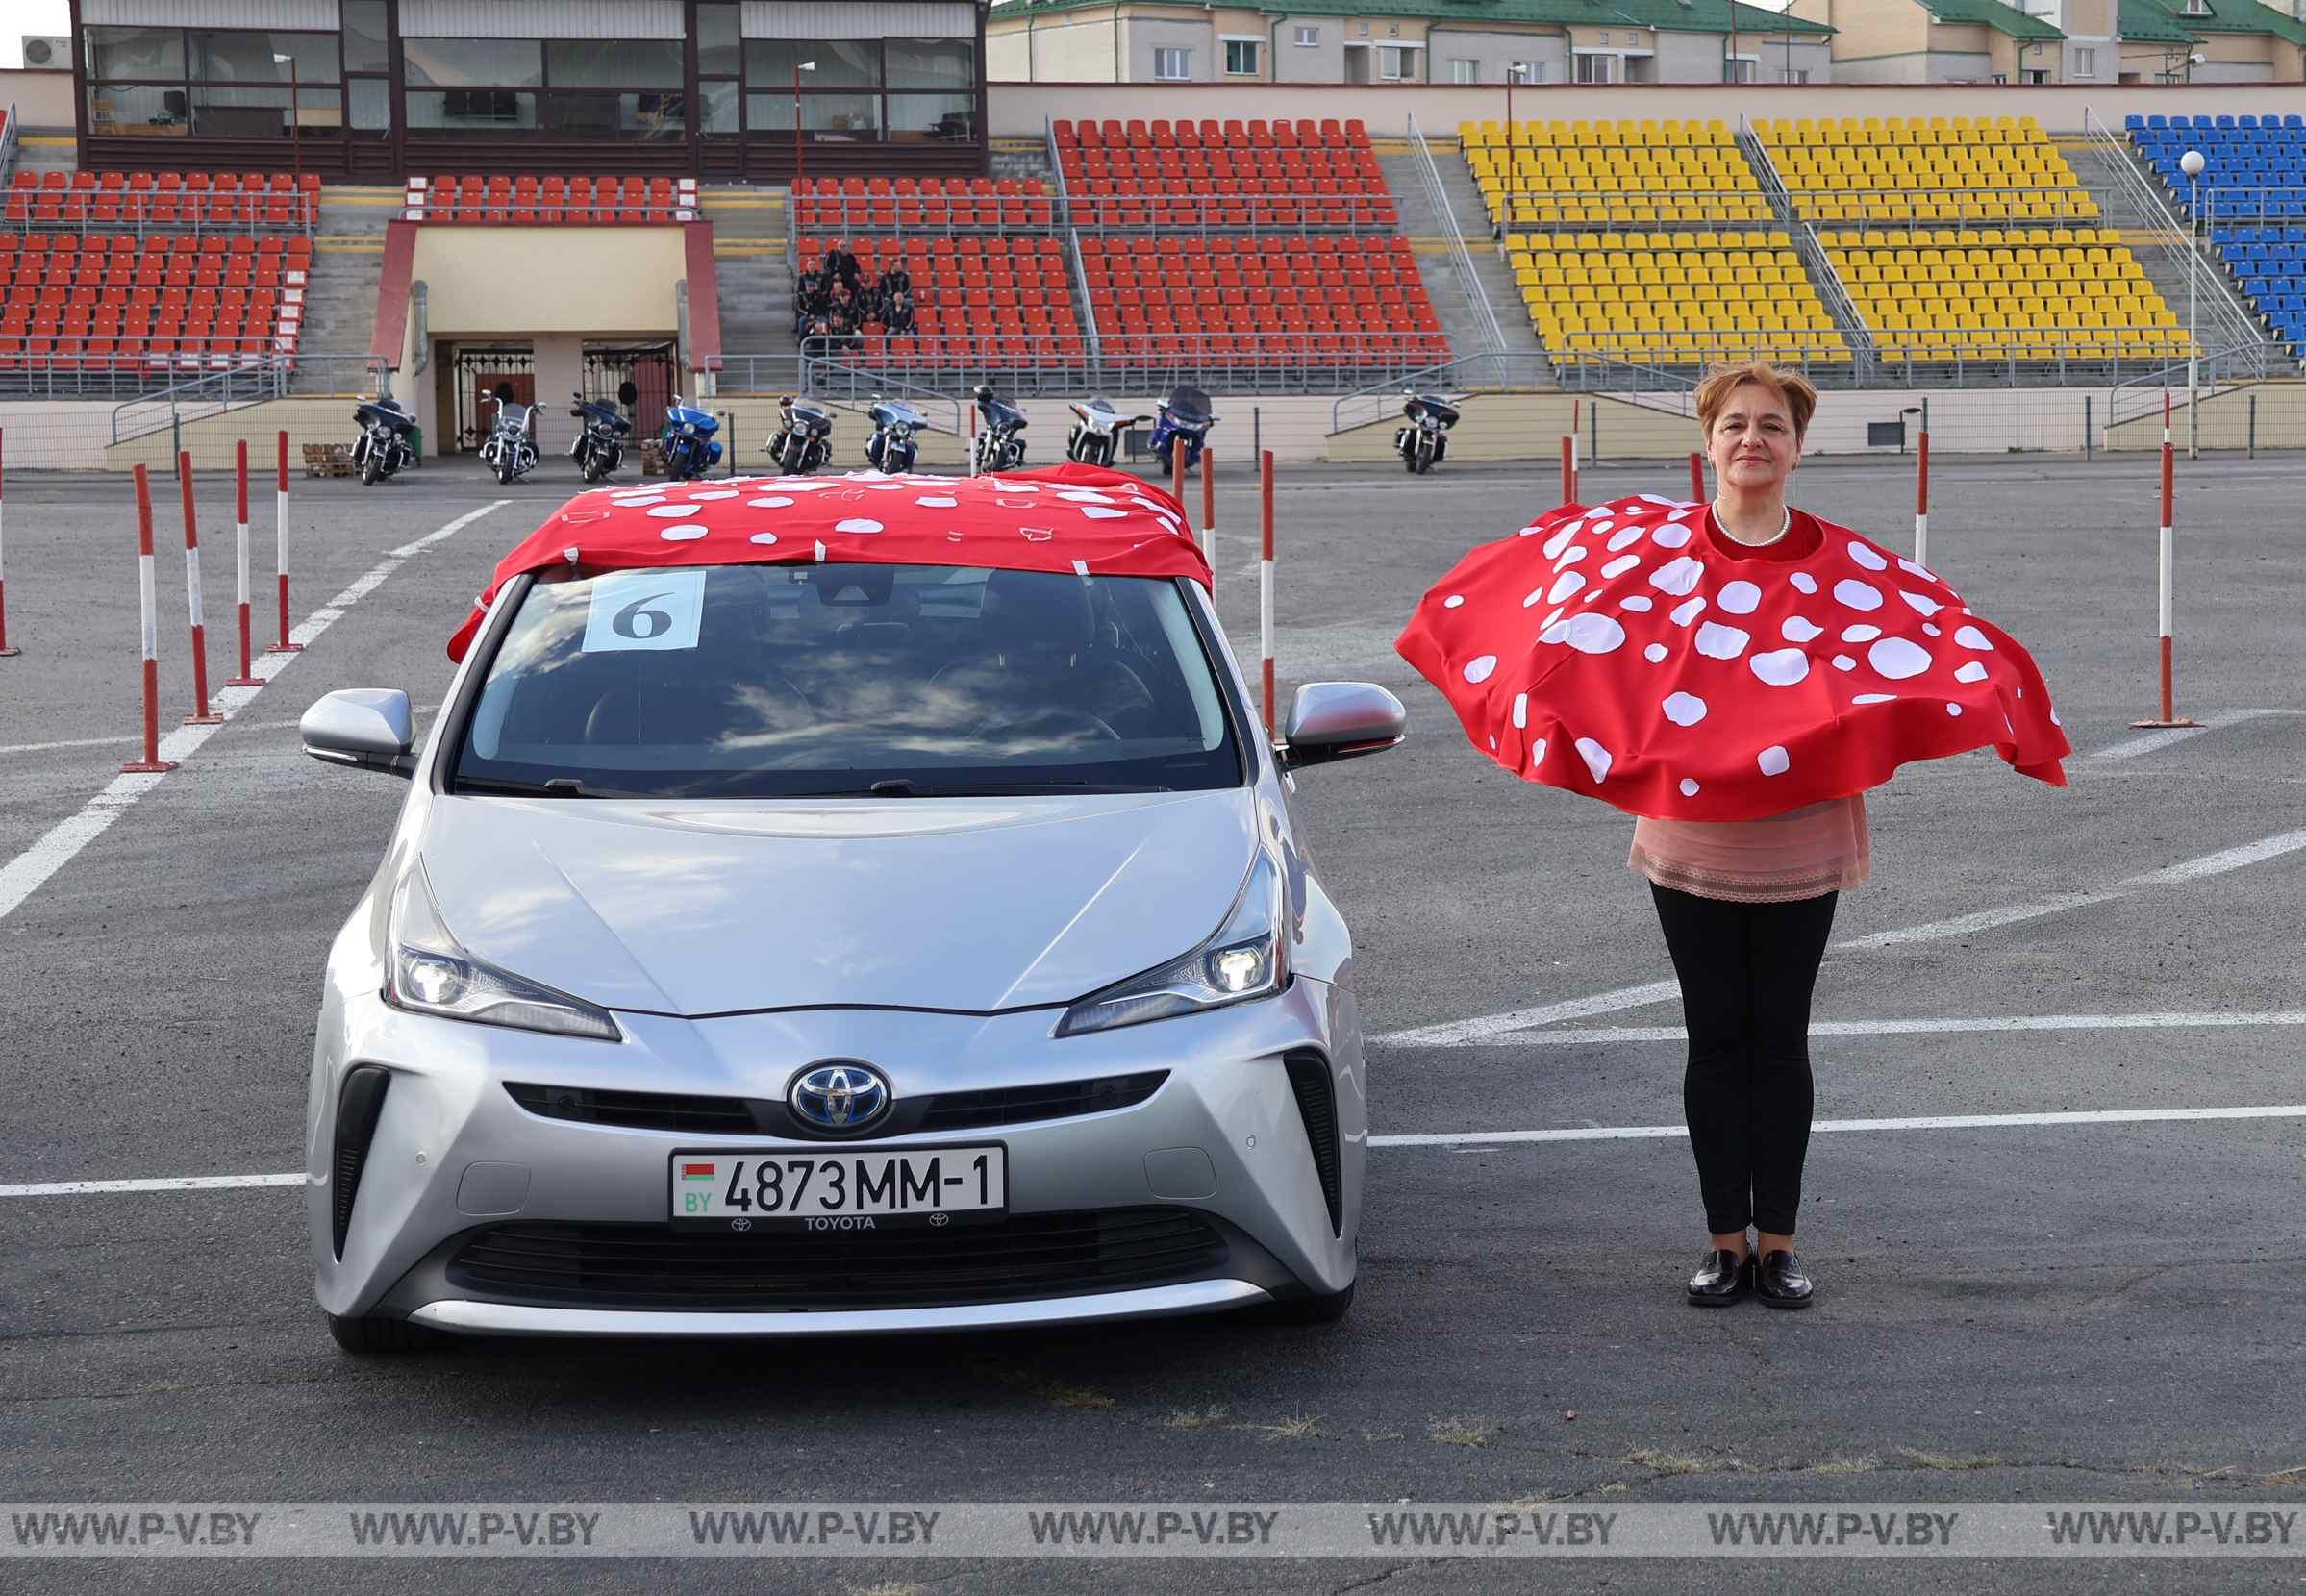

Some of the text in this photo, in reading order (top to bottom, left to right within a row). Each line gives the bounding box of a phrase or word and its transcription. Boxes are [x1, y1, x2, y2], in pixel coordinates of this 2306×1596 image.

[613, 591, 676, 639] 6
[685, 1192, 713, 1212] BY
[804, 1216, 876, 1231] TOYOTA
